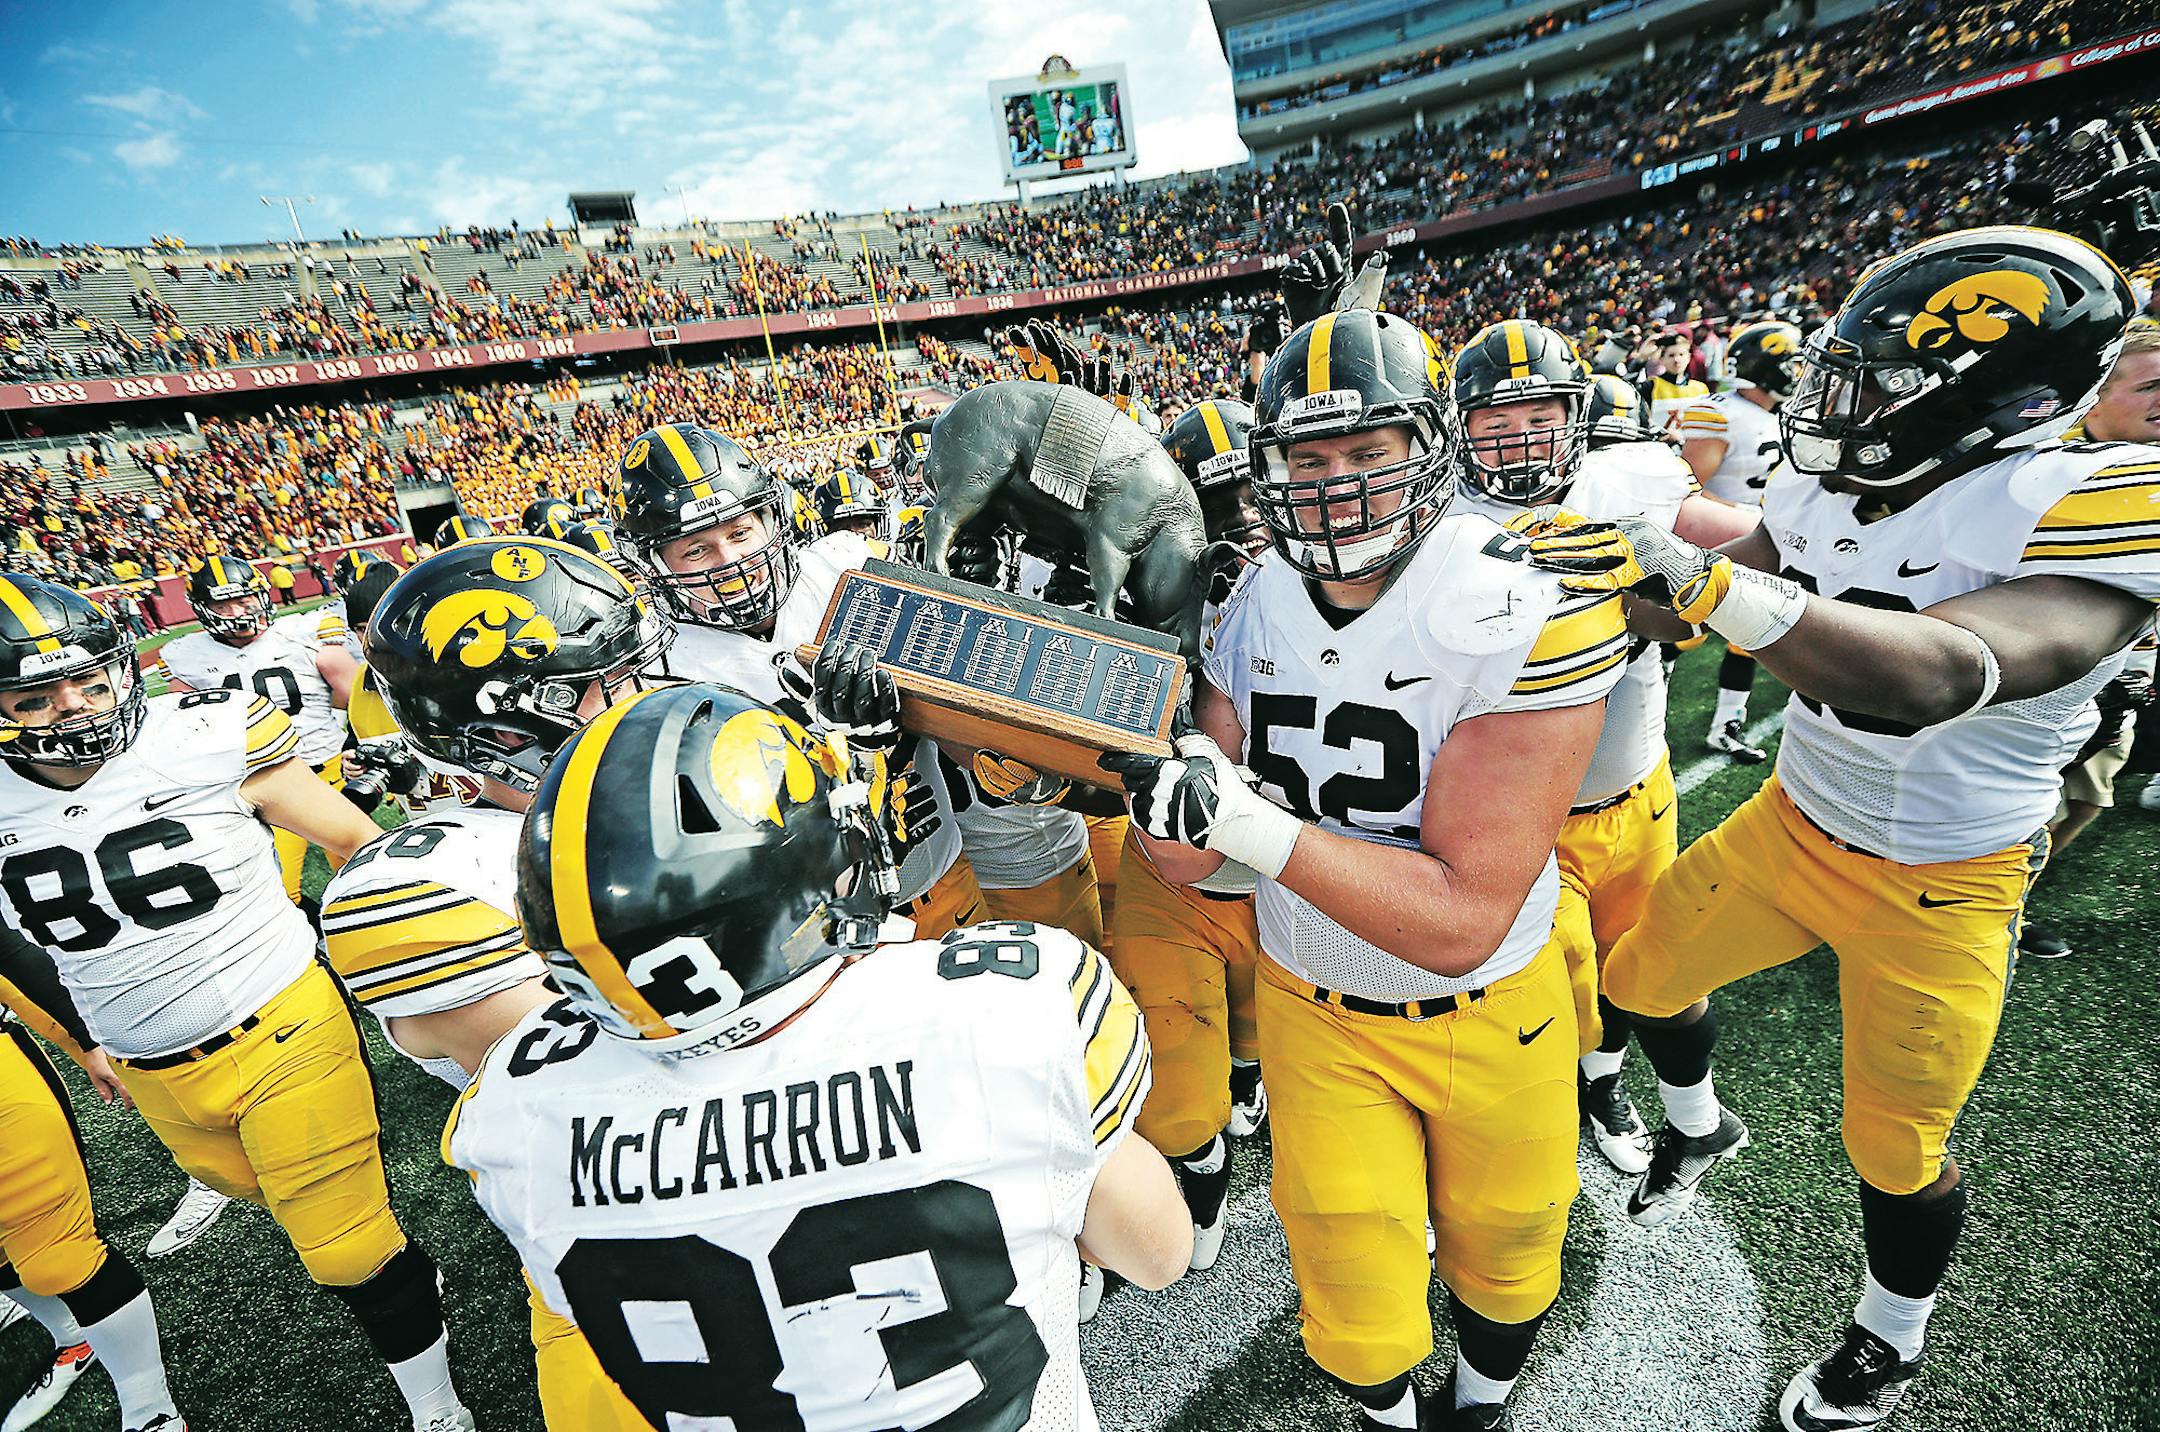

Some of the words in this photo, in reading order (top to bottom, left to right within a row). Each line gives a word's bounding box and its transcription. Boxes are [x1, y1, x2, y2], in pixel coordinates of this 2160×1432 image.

[2124, 35, 2144, 52] of
[2143, 31, 2160, 46] Co
[1044, 285, 1109, 302] NATIONAL
[1115, 264, 1230, 294] CHAMPIONSHIPS
[806, 311, 838, 328] 1904
[986, 294, 1015, 311] 1936
[24, 382, 89, 405] 1933
[110, 376, 170, 399] 1934
[182, 371, 237, 393] 1935
[249, 365, 301, 388] 1937
[314, 359, 363, 381] 1938
[373, 353, 420, 375] 1940
[430, 347, 475, 369] 1941
[485, 342, 527, 363] 1960
[536, 337, 577, 358] 1967
[1510, 377, 1534, 389] IOWA
[1304, 393, 1337, 411] IOWA
[1214, 453, 1241, 468] IOWA
[695, 496, 722, 512] IOWA
[507, 548, 530, 579] ANF
[854, 583, 881, 602] M
[894, 593, 907, 609] I
[916, 600, 944, 620] M
[957, 609, 971, 625] I
[980, 617, 1009, 637] M
[1023, 626, 1034, 643] I
[40, 651, 71, 665] IOWA
[1045, 634, 1072, 654] M
[1087, 644, 1099, 660] I
[1110, 652, 1139, 673] M
[1154, 661, 1166, 678] I
[1247, 691, 1421, 841] 52
[1, 818, 224, 952] 86
[656, 1016, 762, 1063] KEYES
[554, 1178, 1050, 1432] 83
